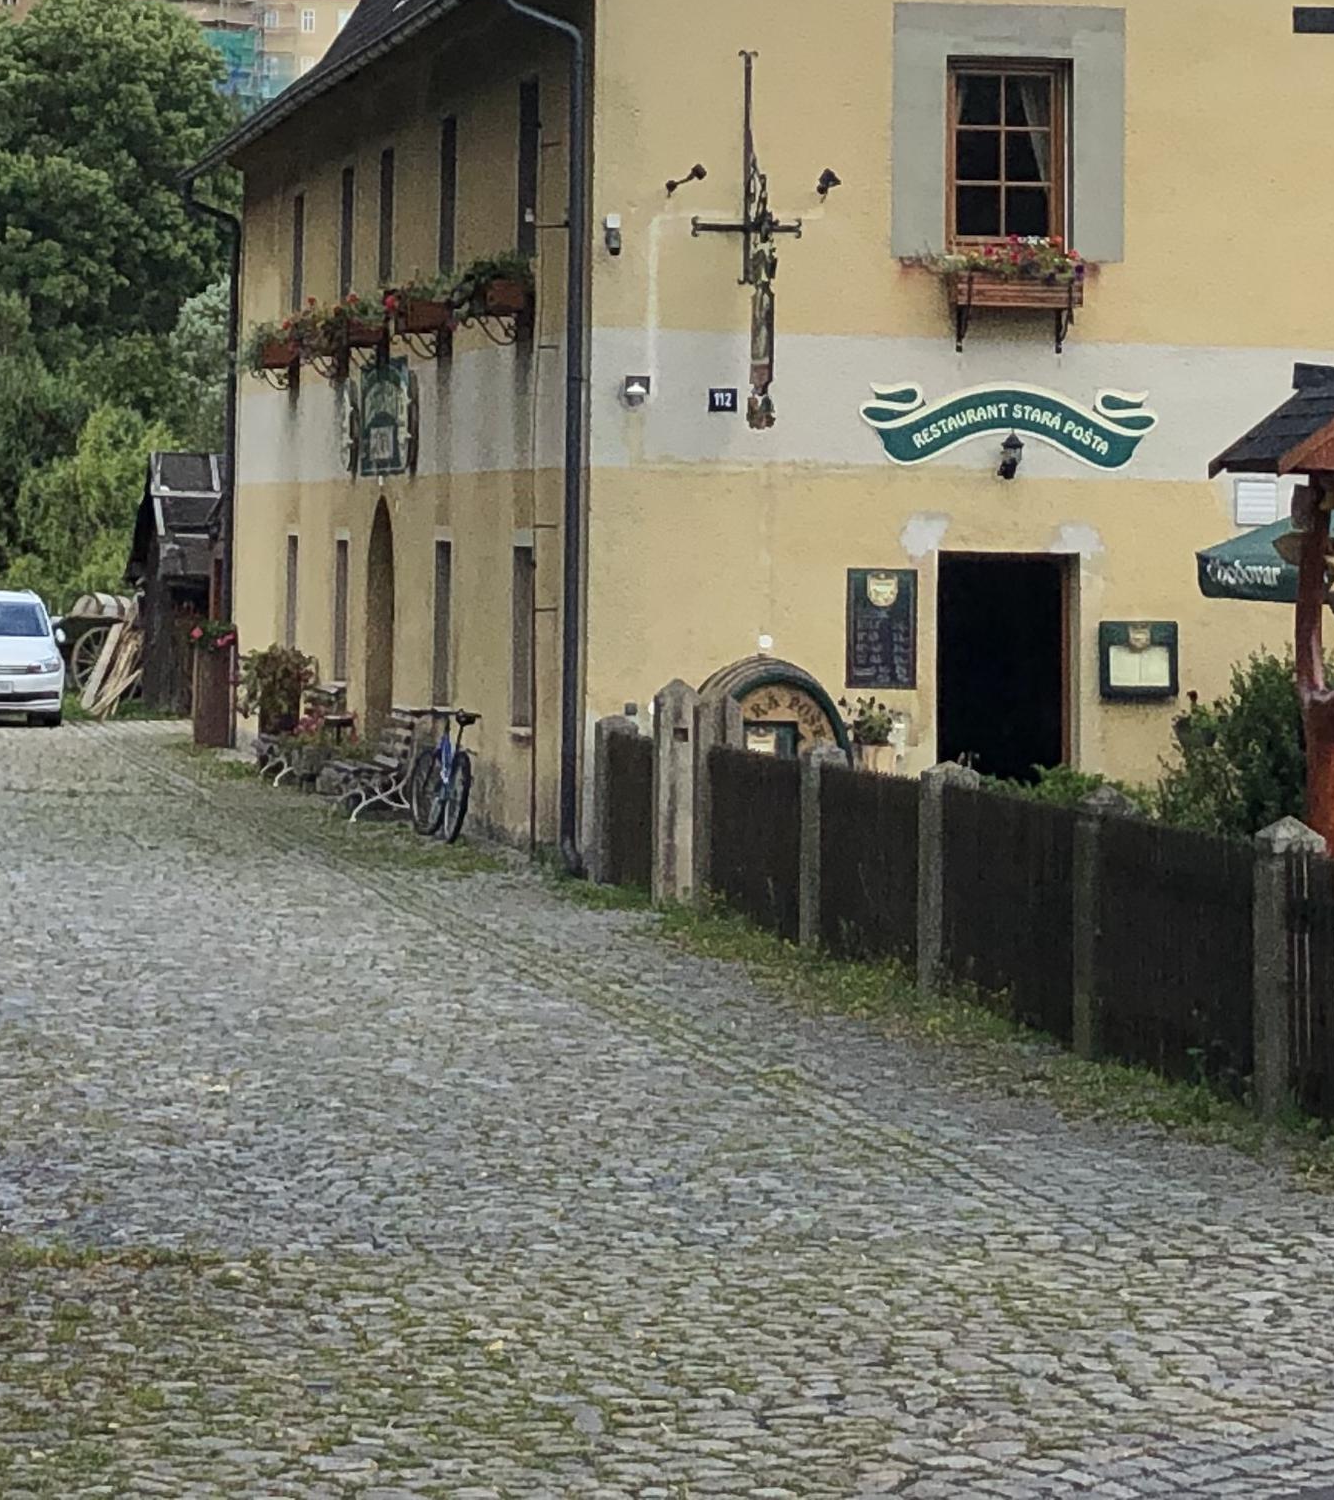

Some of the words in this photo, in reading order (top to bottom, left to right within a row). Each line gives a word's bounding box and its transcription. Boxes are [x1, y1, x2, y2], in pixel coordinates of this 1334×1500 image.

[713, 392, 733, 408] 112
[911, 402, 1008, 449] RESTAURANT
[1012, 403, 1063, 431] STARÁ
[1063, 420, 1110, 457] POŠTA
